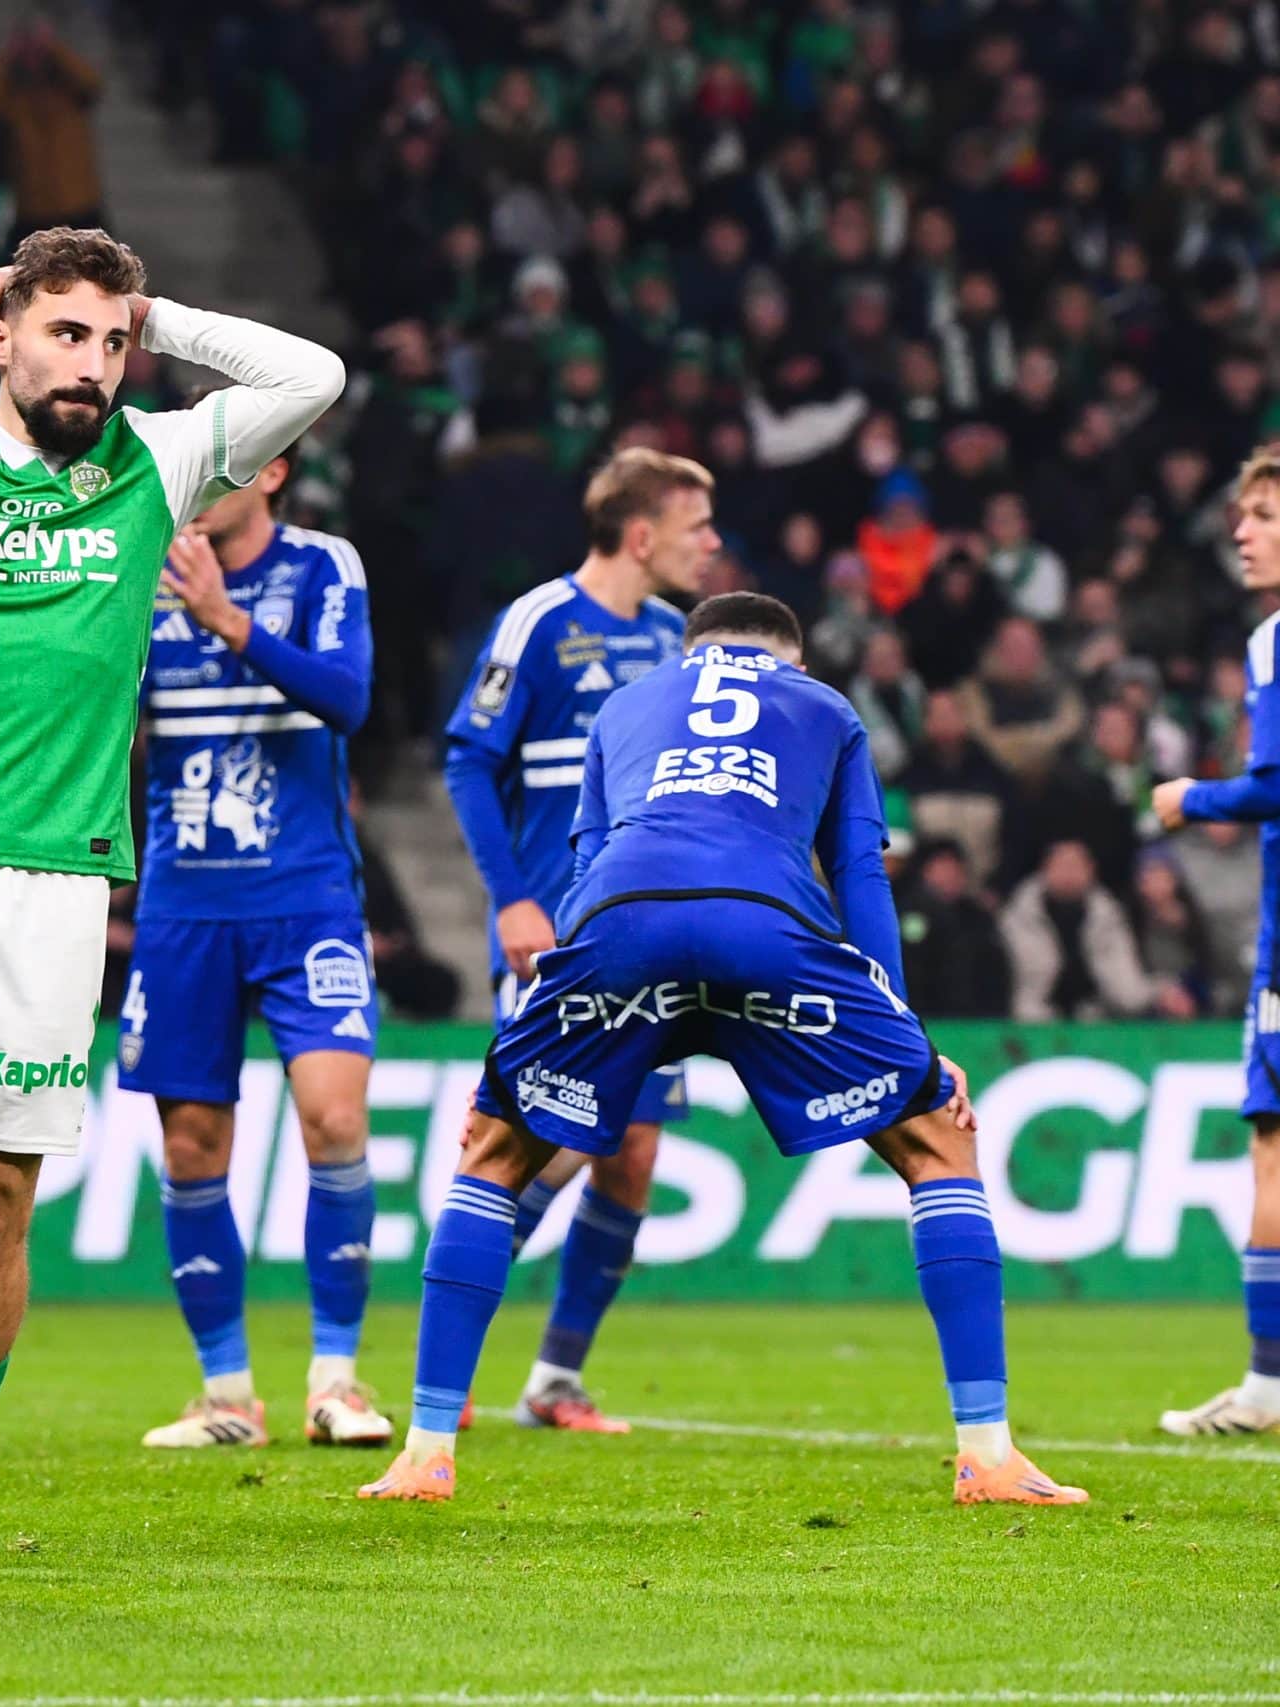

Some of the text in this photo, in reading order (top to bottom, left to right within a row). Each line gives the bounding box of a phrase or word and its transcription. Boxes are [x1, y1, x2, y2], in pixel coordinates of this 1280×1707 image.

[13, 570, 81, 584] INTERIM
[688, 664, 760, 738] 5
[121, 969, 148, 1034] 4
[558, 981, 837, 1036] PIXELED
[540, 1069, 595, 1098] GARAGE
[558, 1089, 598, 1113] COSTA
[805, 1071, 899, 1121] GROOT
[841, 1105, 880, 1126] Coffee
